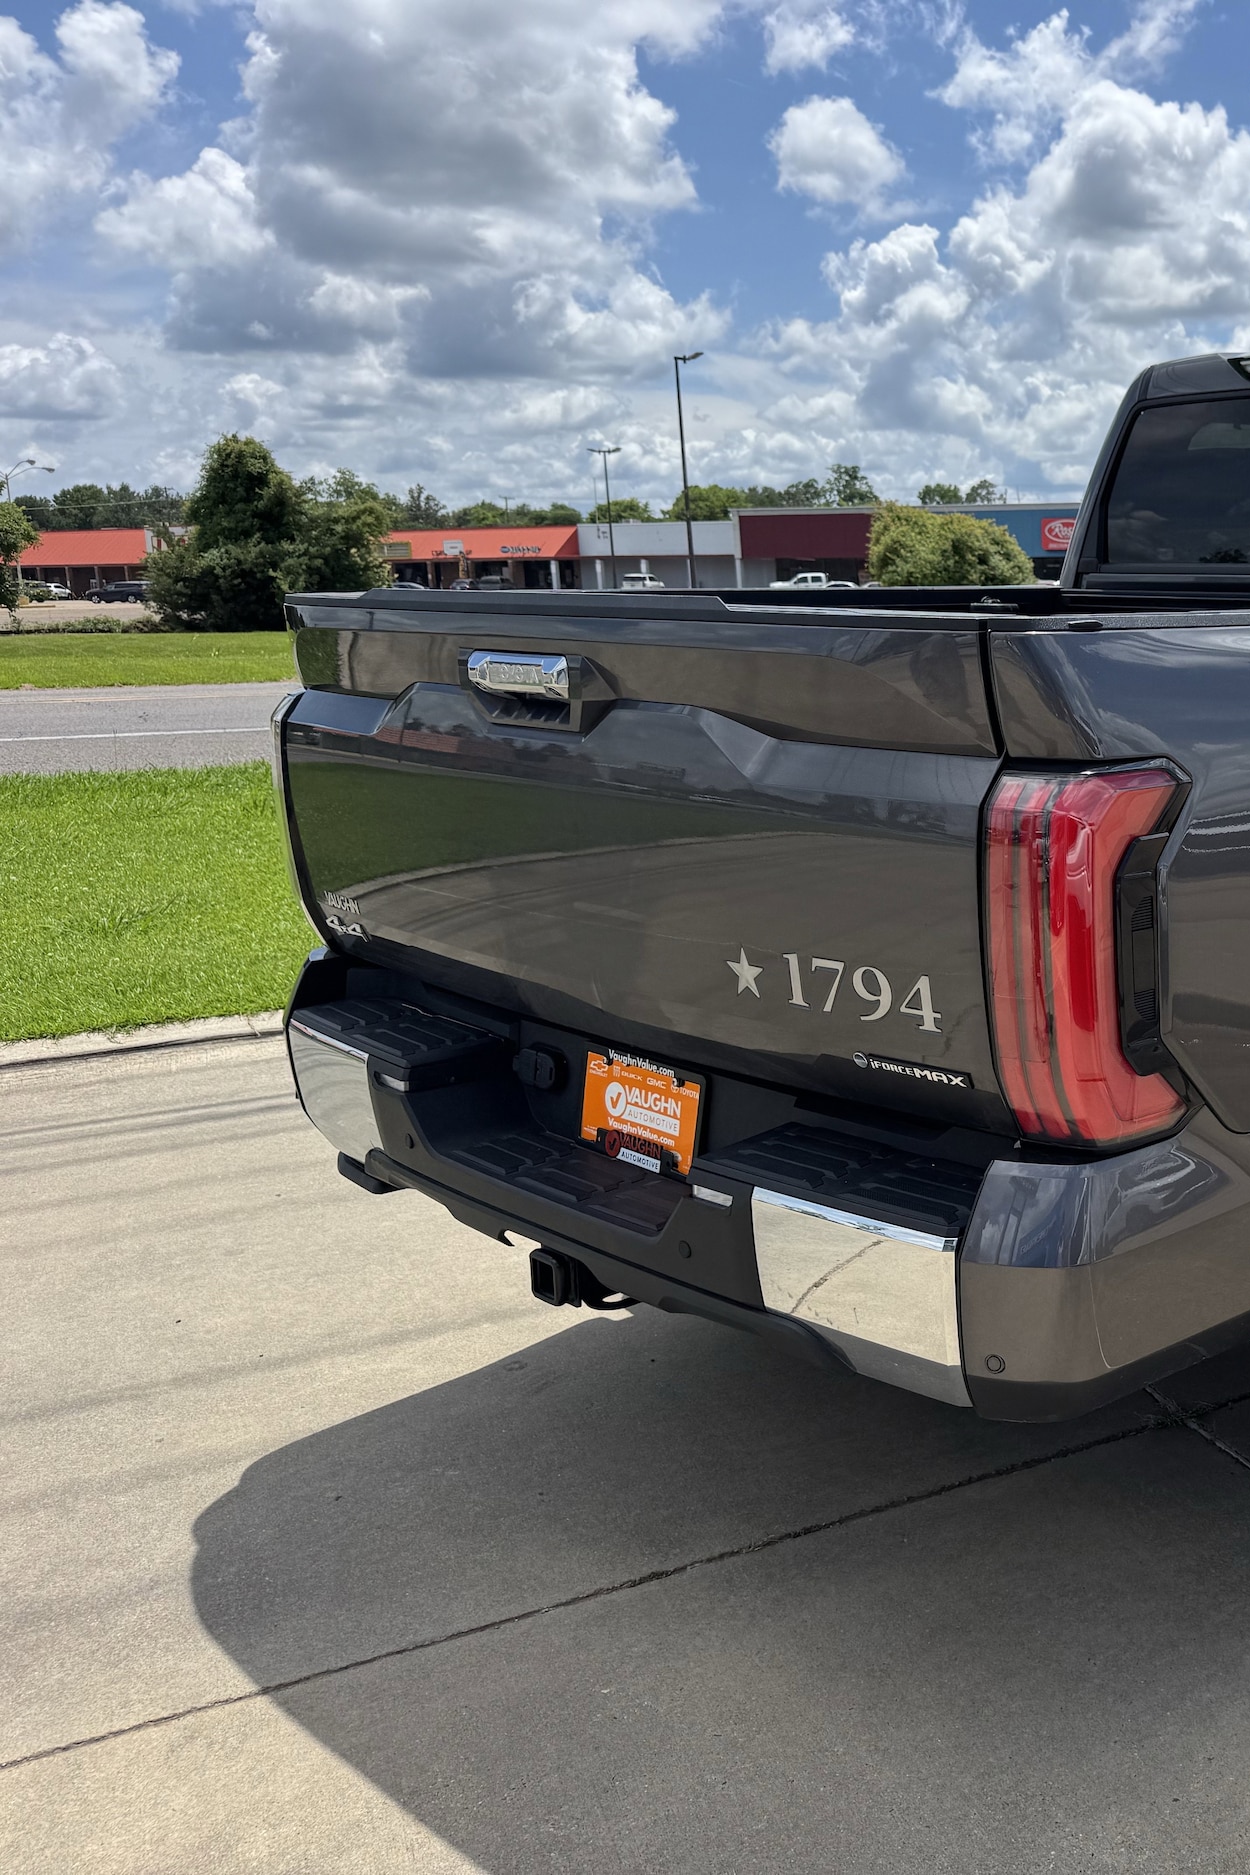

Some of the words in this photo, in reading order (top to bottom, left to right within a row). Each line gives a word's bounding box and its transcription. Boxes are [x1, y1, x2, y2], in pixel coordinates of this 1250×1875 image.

[324, 890, 361, 915] VAUGHN
[782, 952, 942, 1033] 1794
[608, 1049, 675, 1078] VaughnValue.com
[621, 1070, 643, 1081] BUICK
[646, 1077, 667, 1089] GMC
[679, 1086, 700, 1099] TOYOTA
[626, 1085, 681, 1118] VAUGHN
[608, 1117, 675, 1147] VaughnValue.com
[627, 1109, 678, 1132] AUTOMOTIVE
[620, 1132, 661, 1159] VAUGHN
[621, 1150, 659, 1170] AUTOMOTIVE
